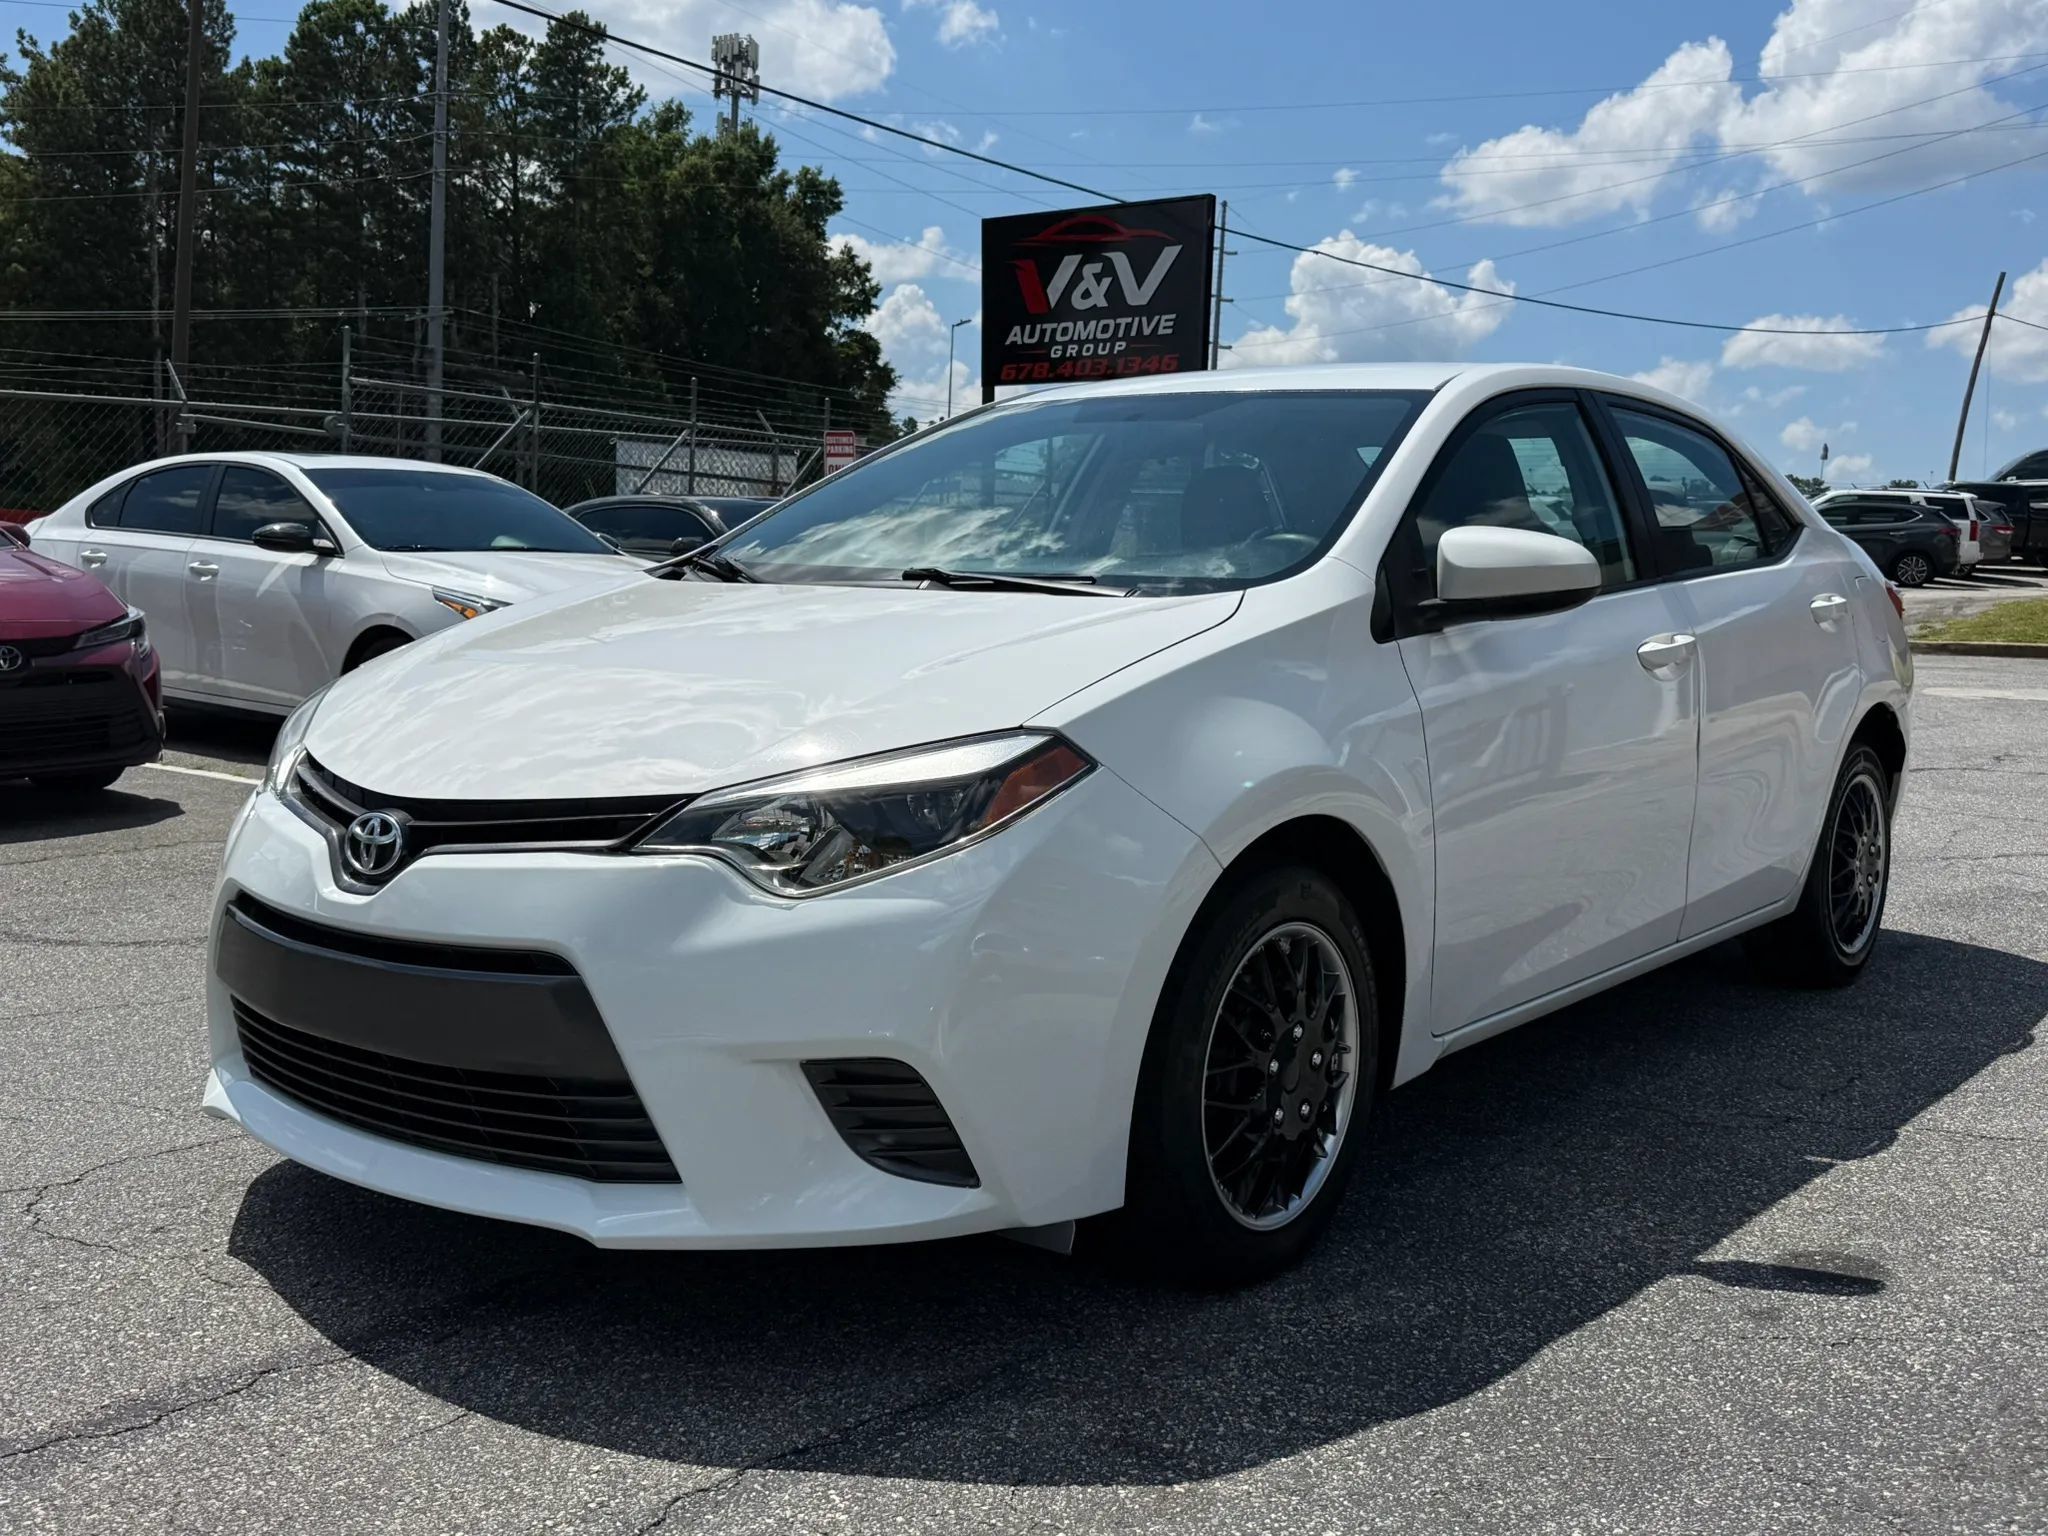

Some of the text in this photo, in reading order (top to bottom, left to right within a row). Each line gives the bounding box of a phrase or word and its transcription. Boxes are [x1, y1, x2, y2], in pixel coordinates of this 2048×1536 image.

[1006, 245, 1183, 314] V&V
[1005, 314, 1176, 345] AUTOMOTIVE
[1050, 342, 1127, 358] GROUP
[1001, 354, 1179, 379] 678.403.1346
[826, 445, 853, 454] PARKING
